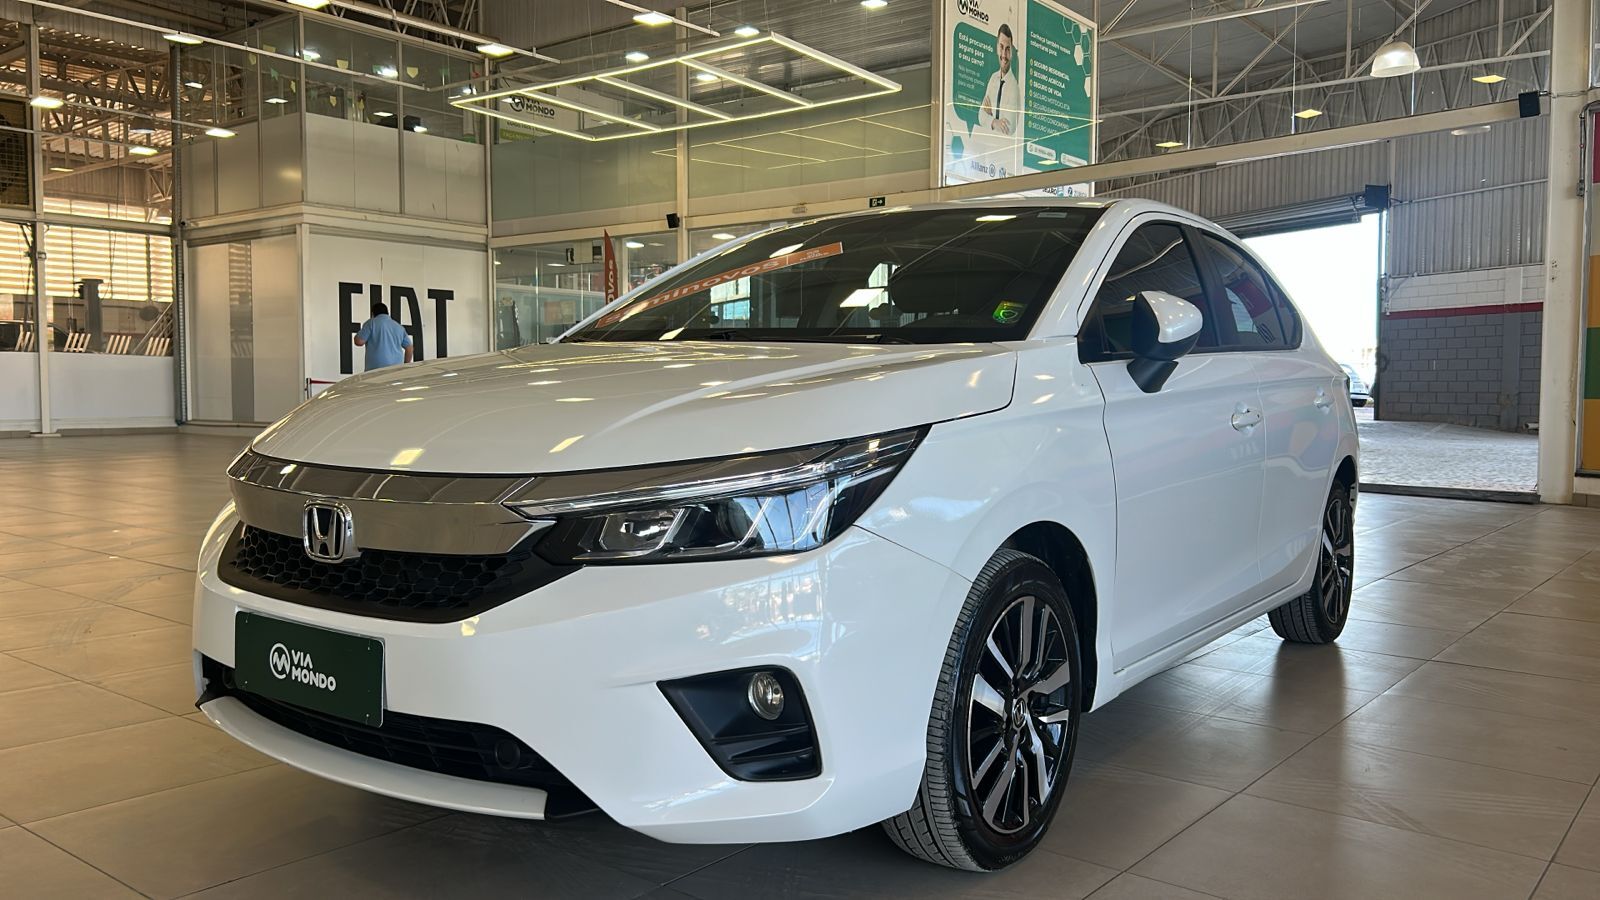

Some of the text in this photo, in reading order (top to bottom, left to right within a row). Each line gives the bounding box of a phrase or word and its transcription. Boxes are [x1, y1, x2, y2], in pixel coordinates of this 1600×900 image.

[968, 6, 989, 22] MONDO
[959, 32, 993, 53] Está procurando
[959, 43, 985, 59] seguro para
[1033, 60, 1070, 81] SEGURO RESIDENCIAL
[1033, 70, 1048, 82] SEGURO
[1033, 80, 1048, 92] SEGURO
[526, 102, 555, 117] MONDO
[291, 649, 313, 669] VIA
[291, 666, 337, 692] MONDO
